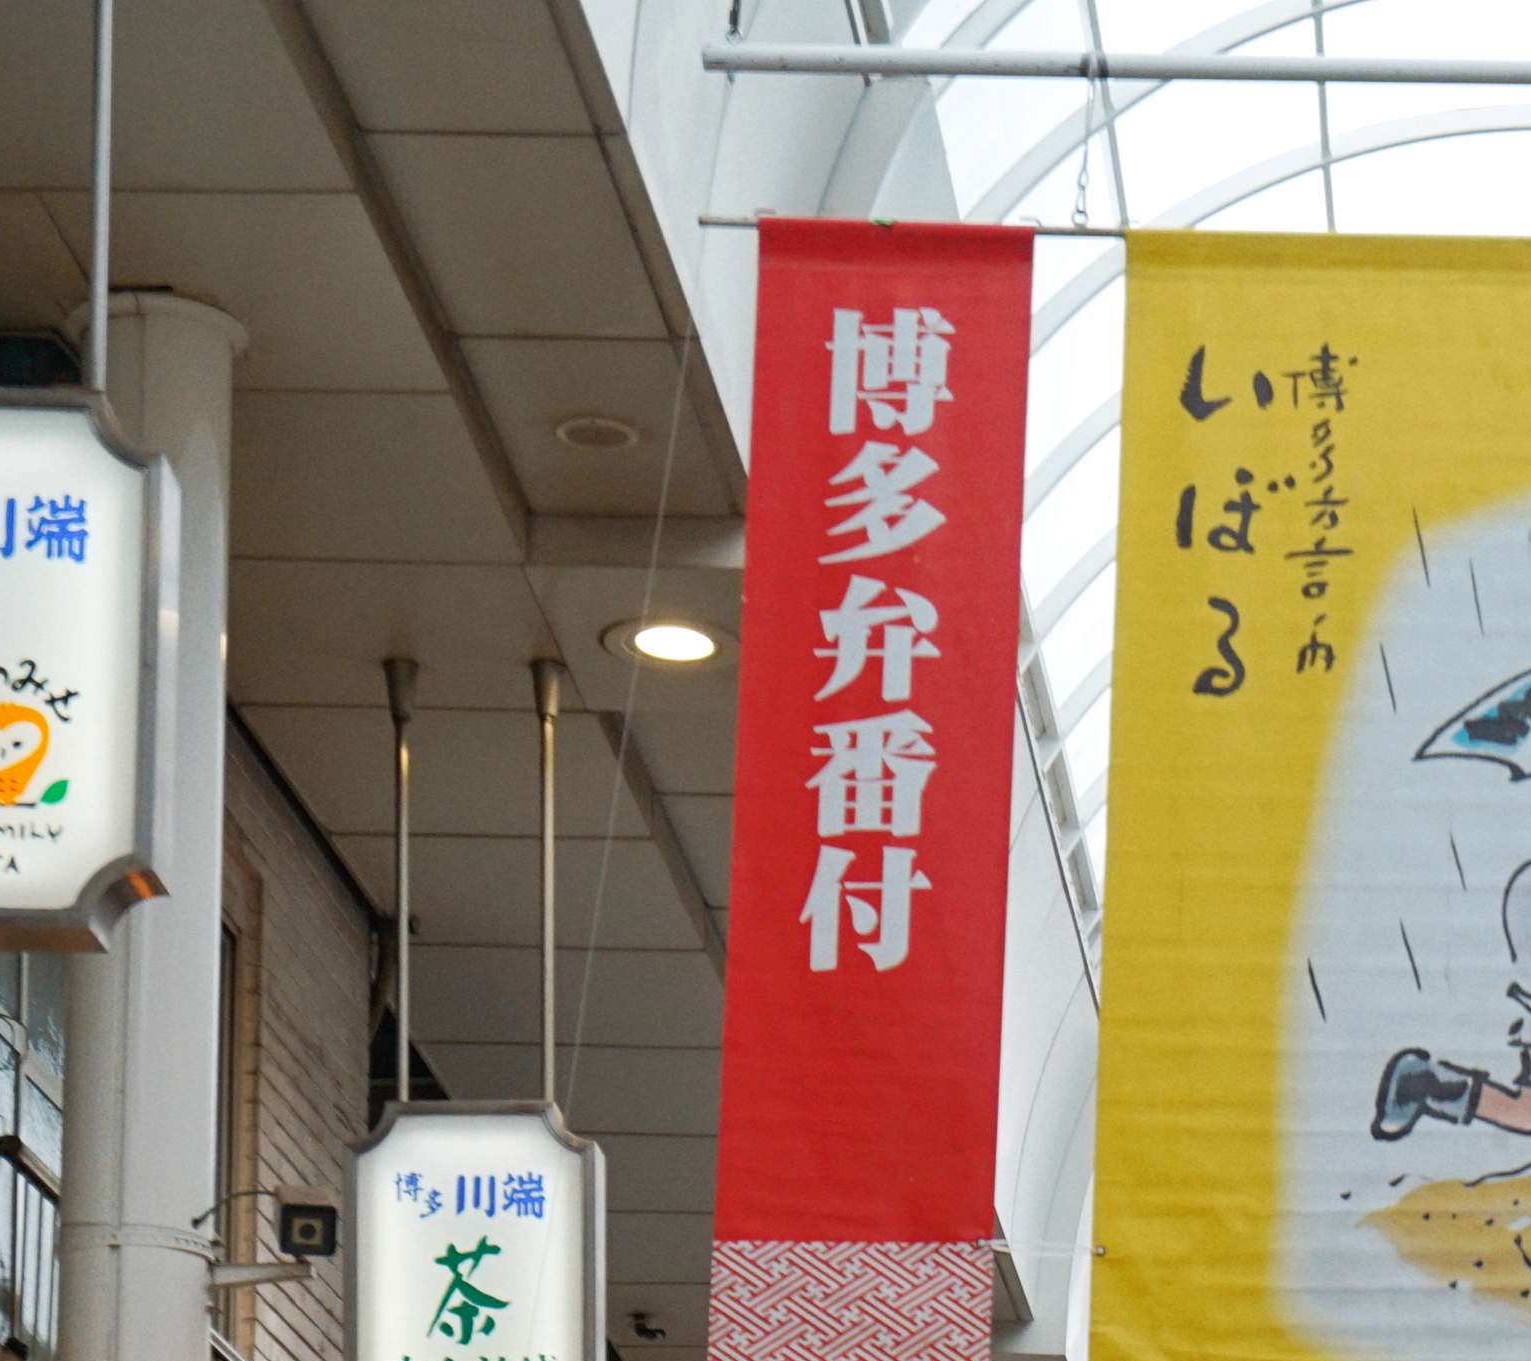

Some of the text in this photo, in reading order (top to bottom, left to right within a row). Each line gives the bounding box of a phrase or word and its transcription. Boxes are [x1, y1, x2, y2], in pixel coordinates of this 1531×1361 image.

[799, 307, 954, 973] 博多弁番付
[394, 1172, 545, 1219] 博多川端
[427, 1235, 511, 1346] 茶
